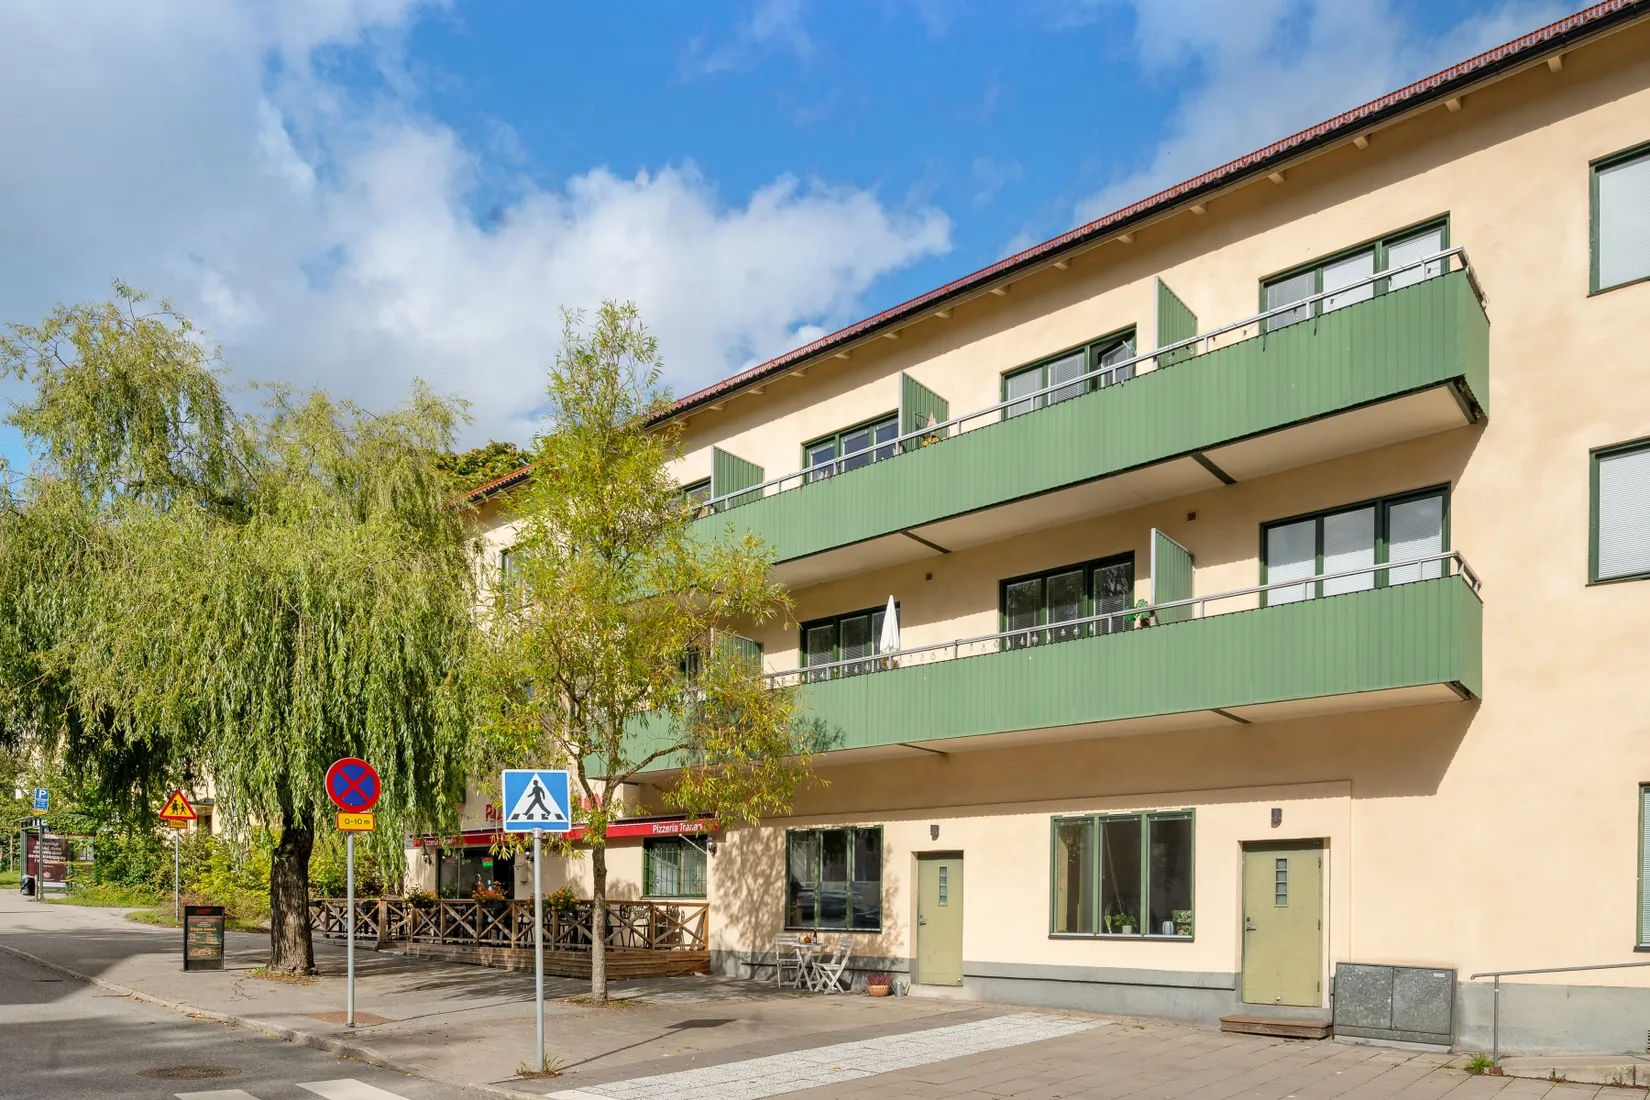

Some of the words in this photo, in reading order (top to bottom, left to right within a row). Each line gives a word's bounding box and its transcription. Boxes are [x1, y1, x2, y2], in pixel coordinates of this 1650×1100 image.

[38, 789, 47, 798] P
[344, 817, 363, 825] 0-10
[652, 822, 679, 834] Pizzeria
